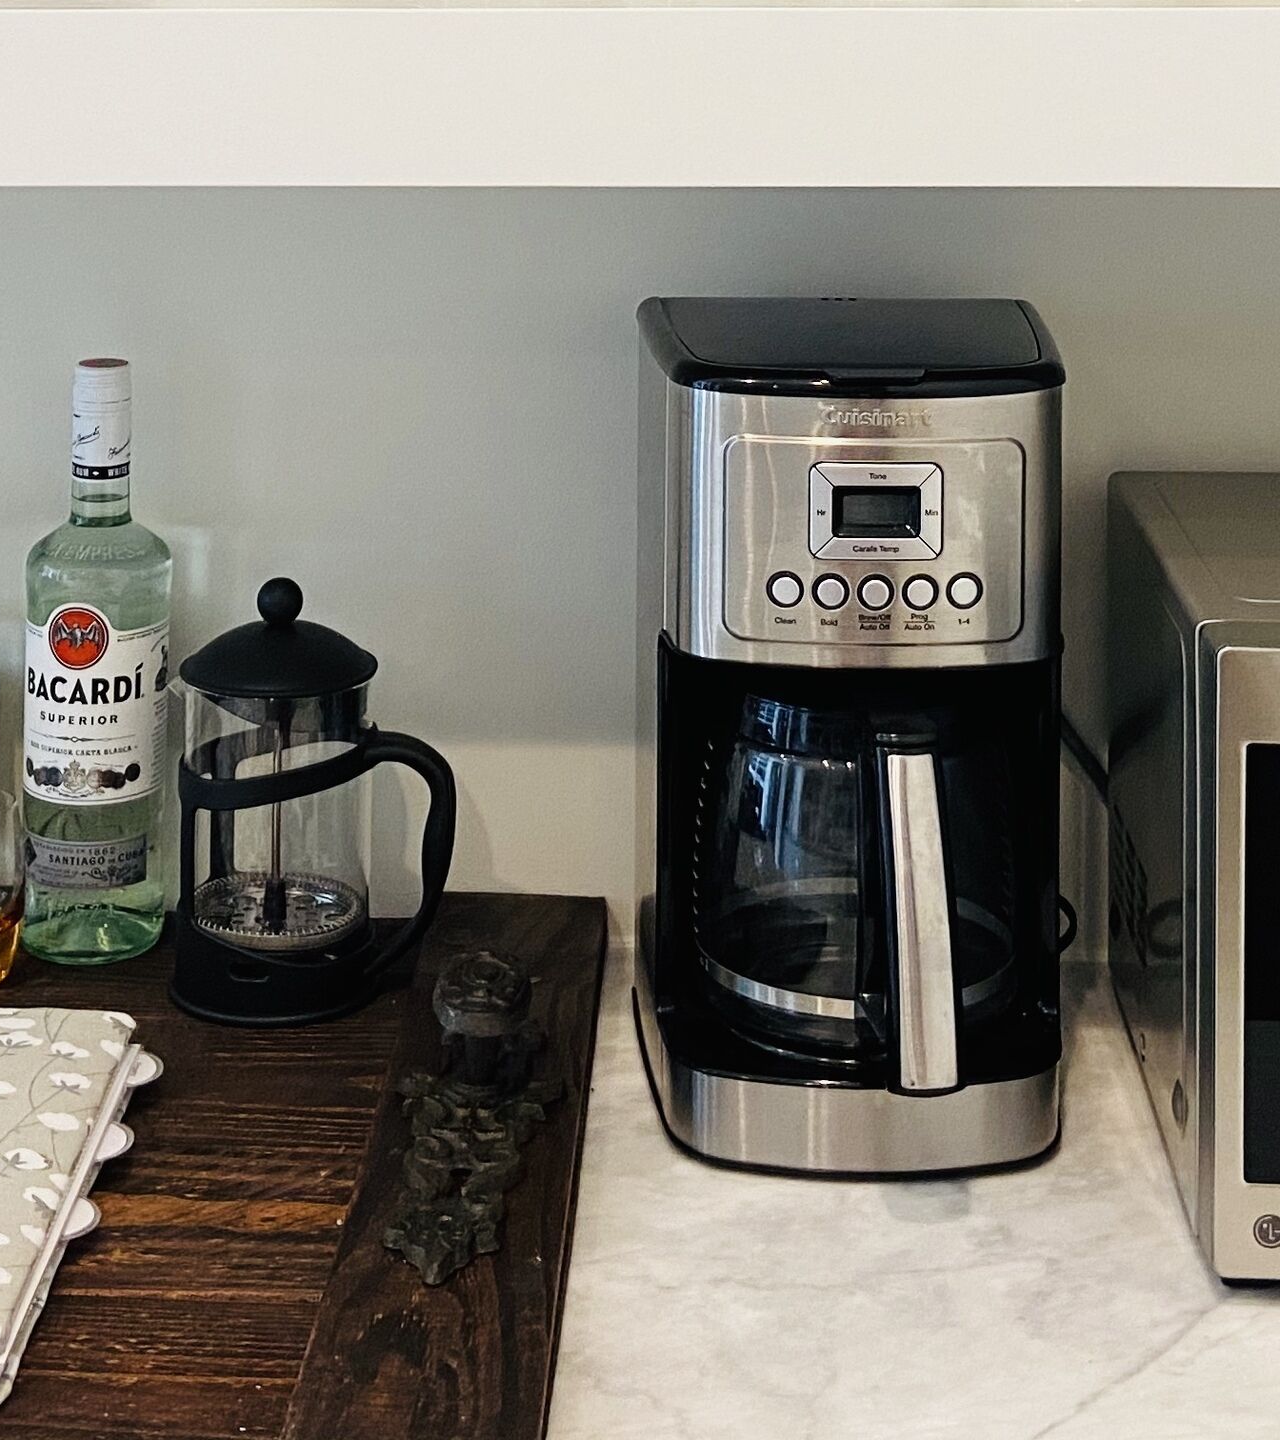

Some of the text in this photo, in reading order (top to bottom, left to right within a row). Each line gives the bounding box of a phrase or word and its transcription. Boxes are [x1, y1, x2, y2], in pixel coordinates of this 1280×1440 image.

[820, 403, 931, 426] Cuisinart
[40, 711, 118, 725] SUPERIOR
[49, 854, 105, 865] SANTIAGO
